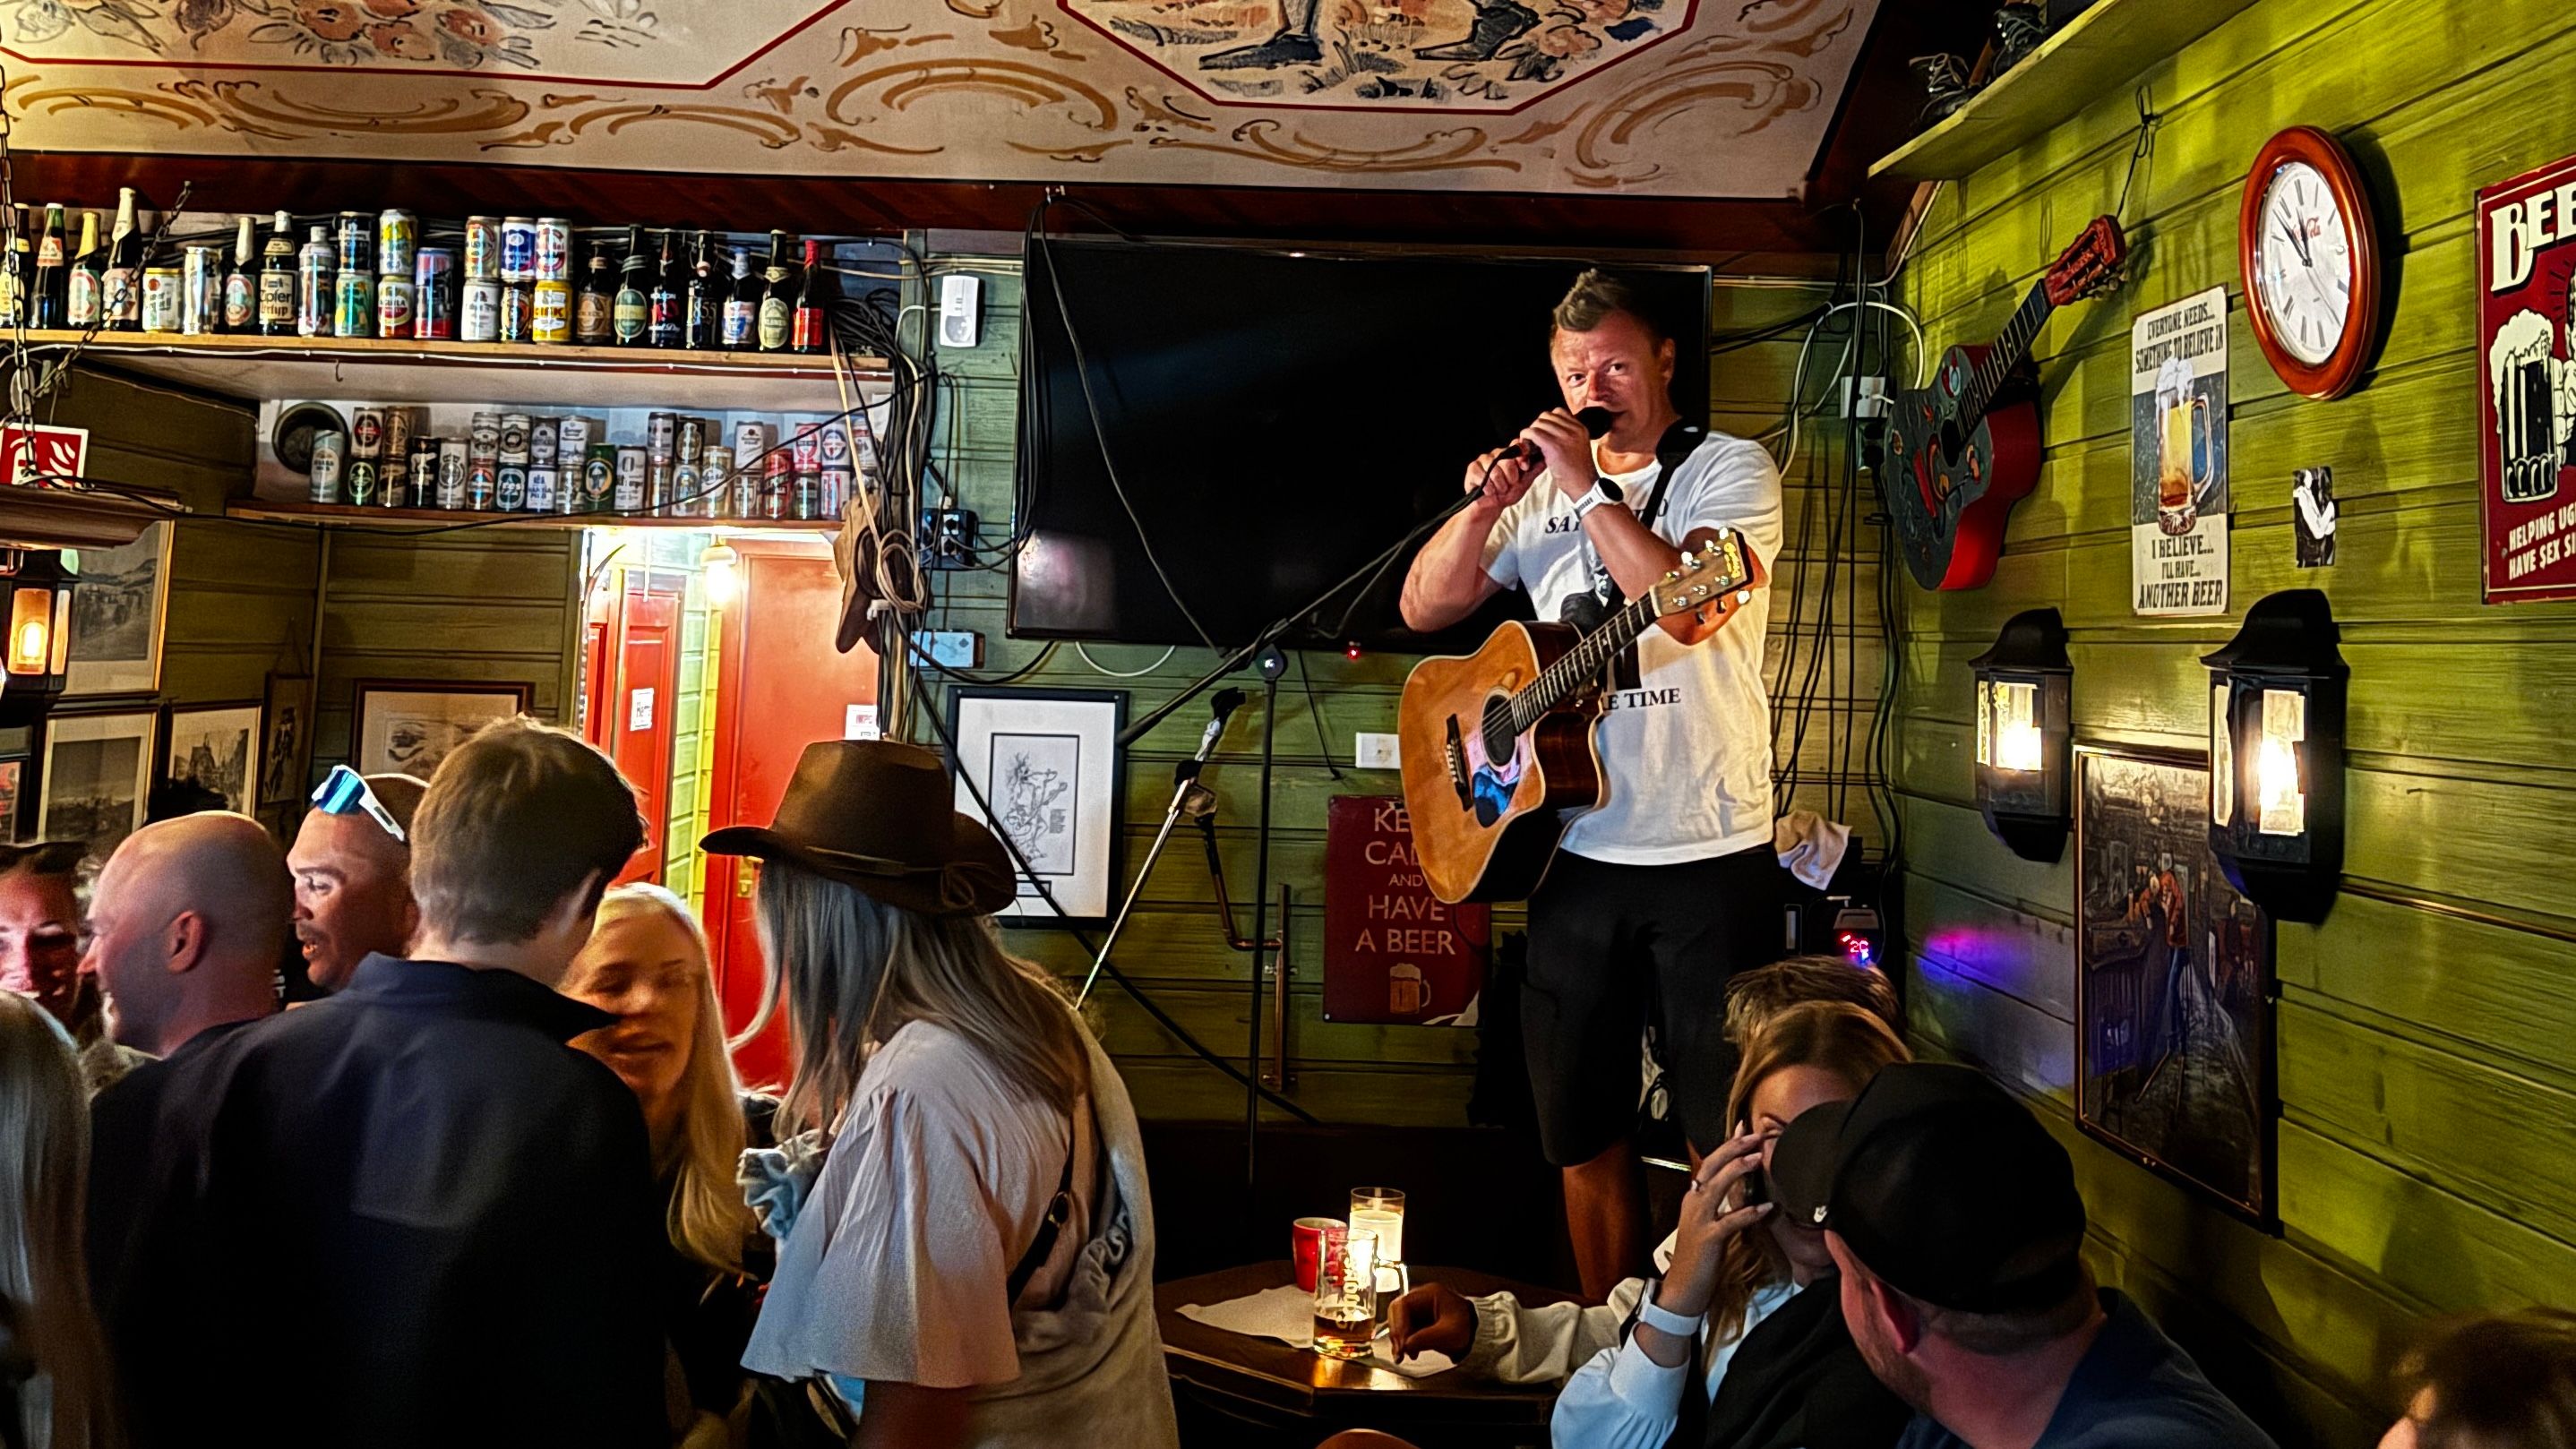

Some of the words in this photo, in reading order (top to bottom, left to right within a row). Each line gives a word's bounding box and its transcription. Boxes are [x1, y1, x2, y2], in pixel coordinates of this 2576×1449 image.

[2147, 310, 2182, 340] EVERYONE
[2184, 302, 2216, 329] NEEDS...
[2135, 339, 2173, 373] SOMETHING
[2174, 336, 2182, 362] TO
[2183, 328, 2213, 360] BELIEVE
[2215, 323, 2224, 351] IN
[2509, 511, 2555, 552] HELPING
[2151, 539, 2157, 560] I
[2159, 534, 2214, 559] BELIEVE...
[2509, 548, 2537, 580] HAVE
[2539, 538, 2561, 570] SEX
[2138, 582, 2188, 609] ANOTHER
[2192, 579, 2223, 606] BEER
[1624, 688, 1681, 707] TIME
[1374, 809, 1412, 832] KE
[1365, 841, 1421, 866] CAL
[1388, 874, 1423, 887] AND
[1369, 896, 1445, 921] HAVE
[1355, 929, 1376, 952] A
[1387, 930, 1455, 956] BEER
